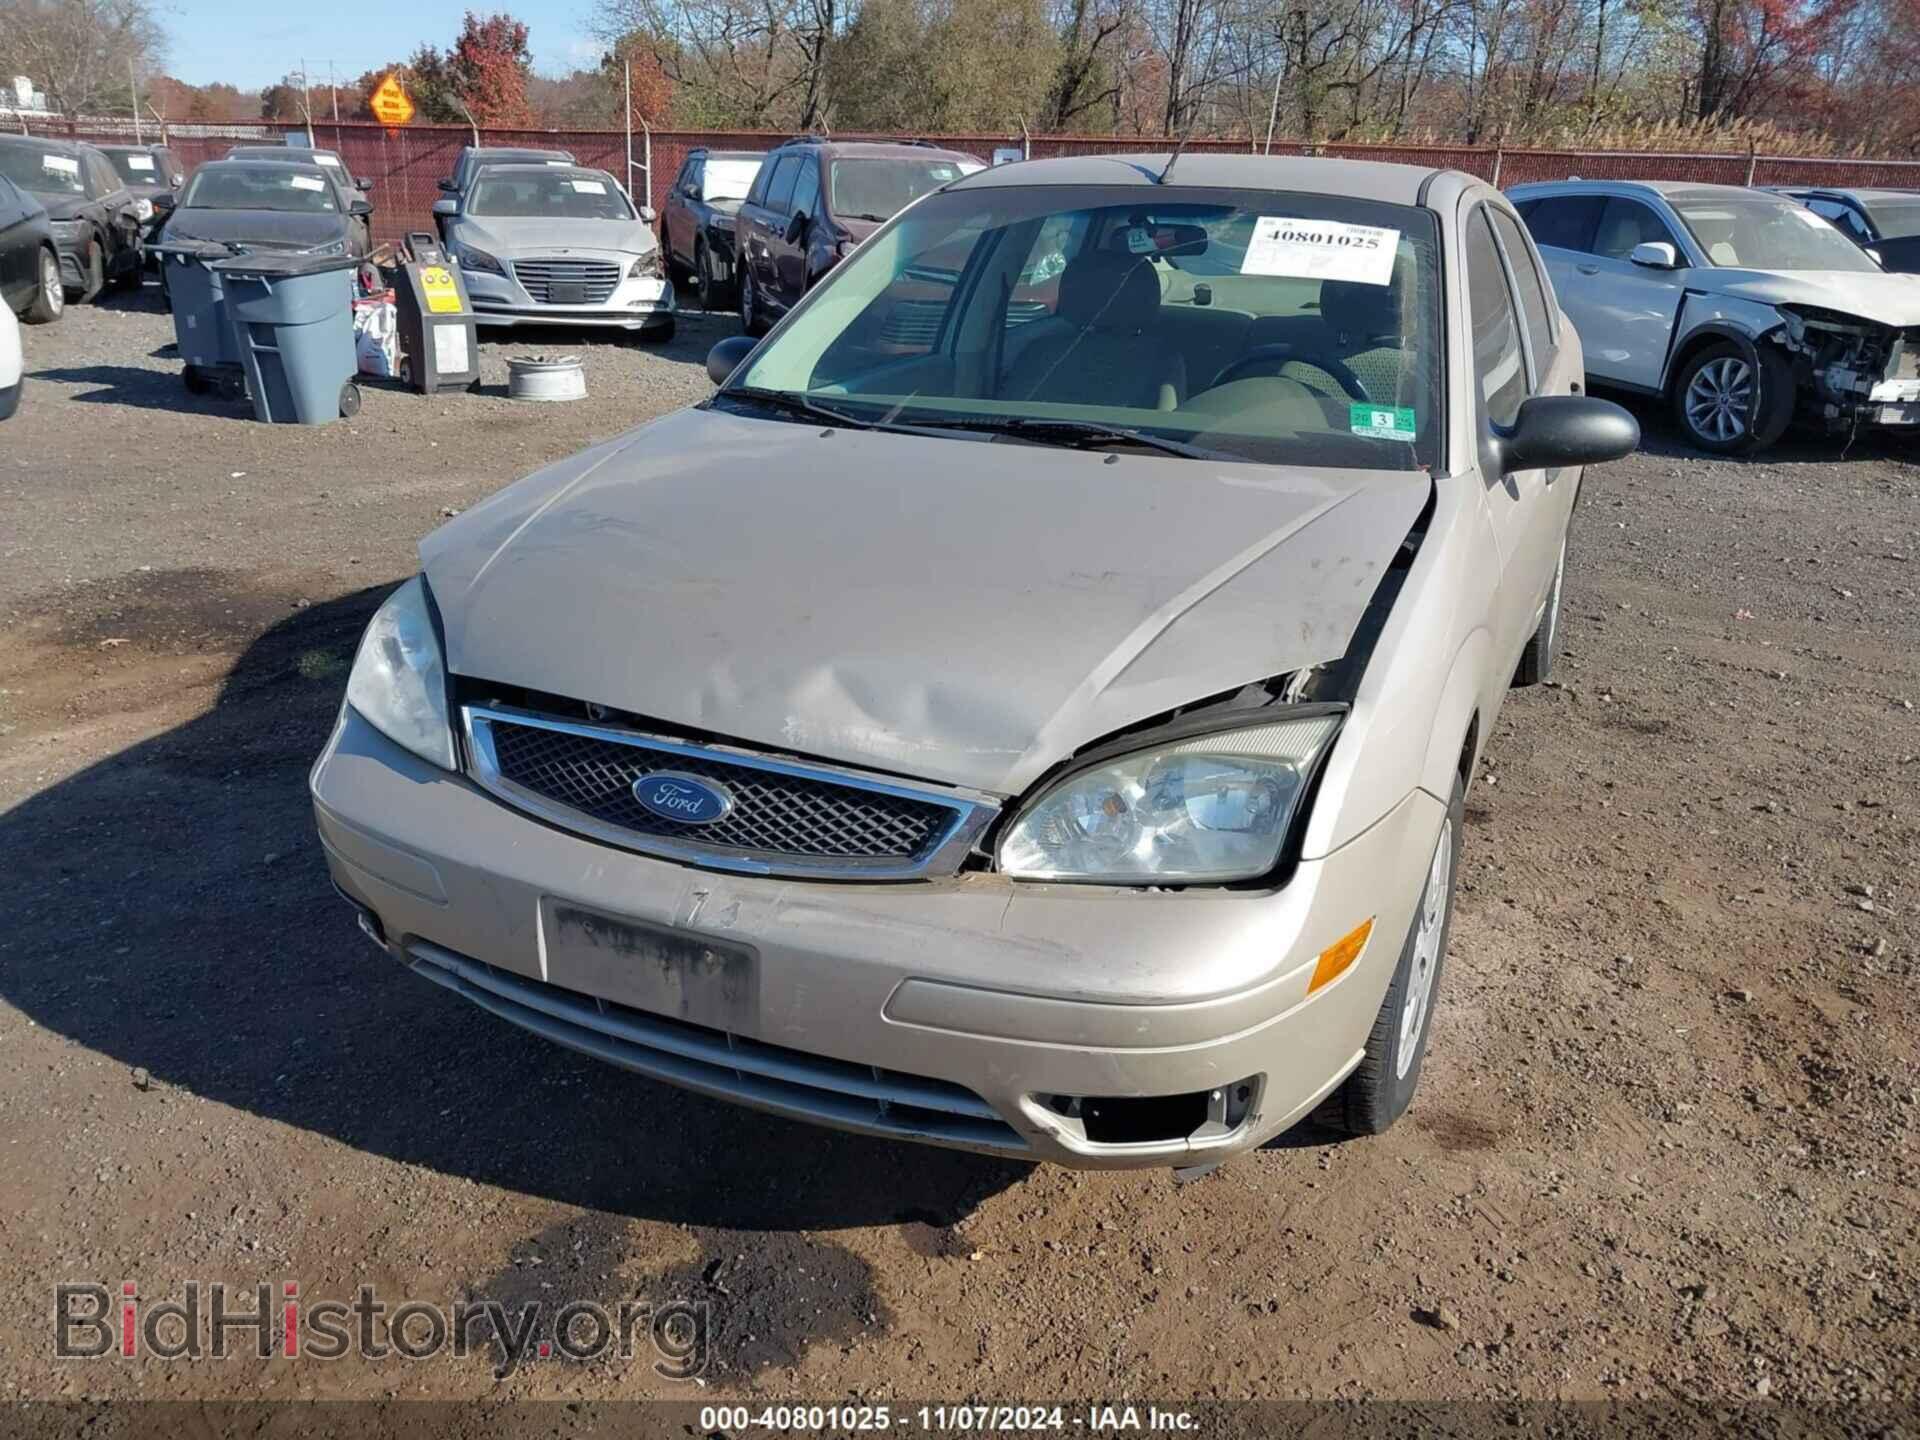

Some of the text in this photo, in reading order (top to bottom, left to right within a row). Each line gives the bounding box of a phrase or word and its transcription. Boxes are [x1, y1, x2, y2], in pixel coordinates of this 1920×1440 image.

[1266, 230, 1381, 249] 40801025
[1378, 414, 1387, 426] 3
[653, 783, 705, 814] Ford
